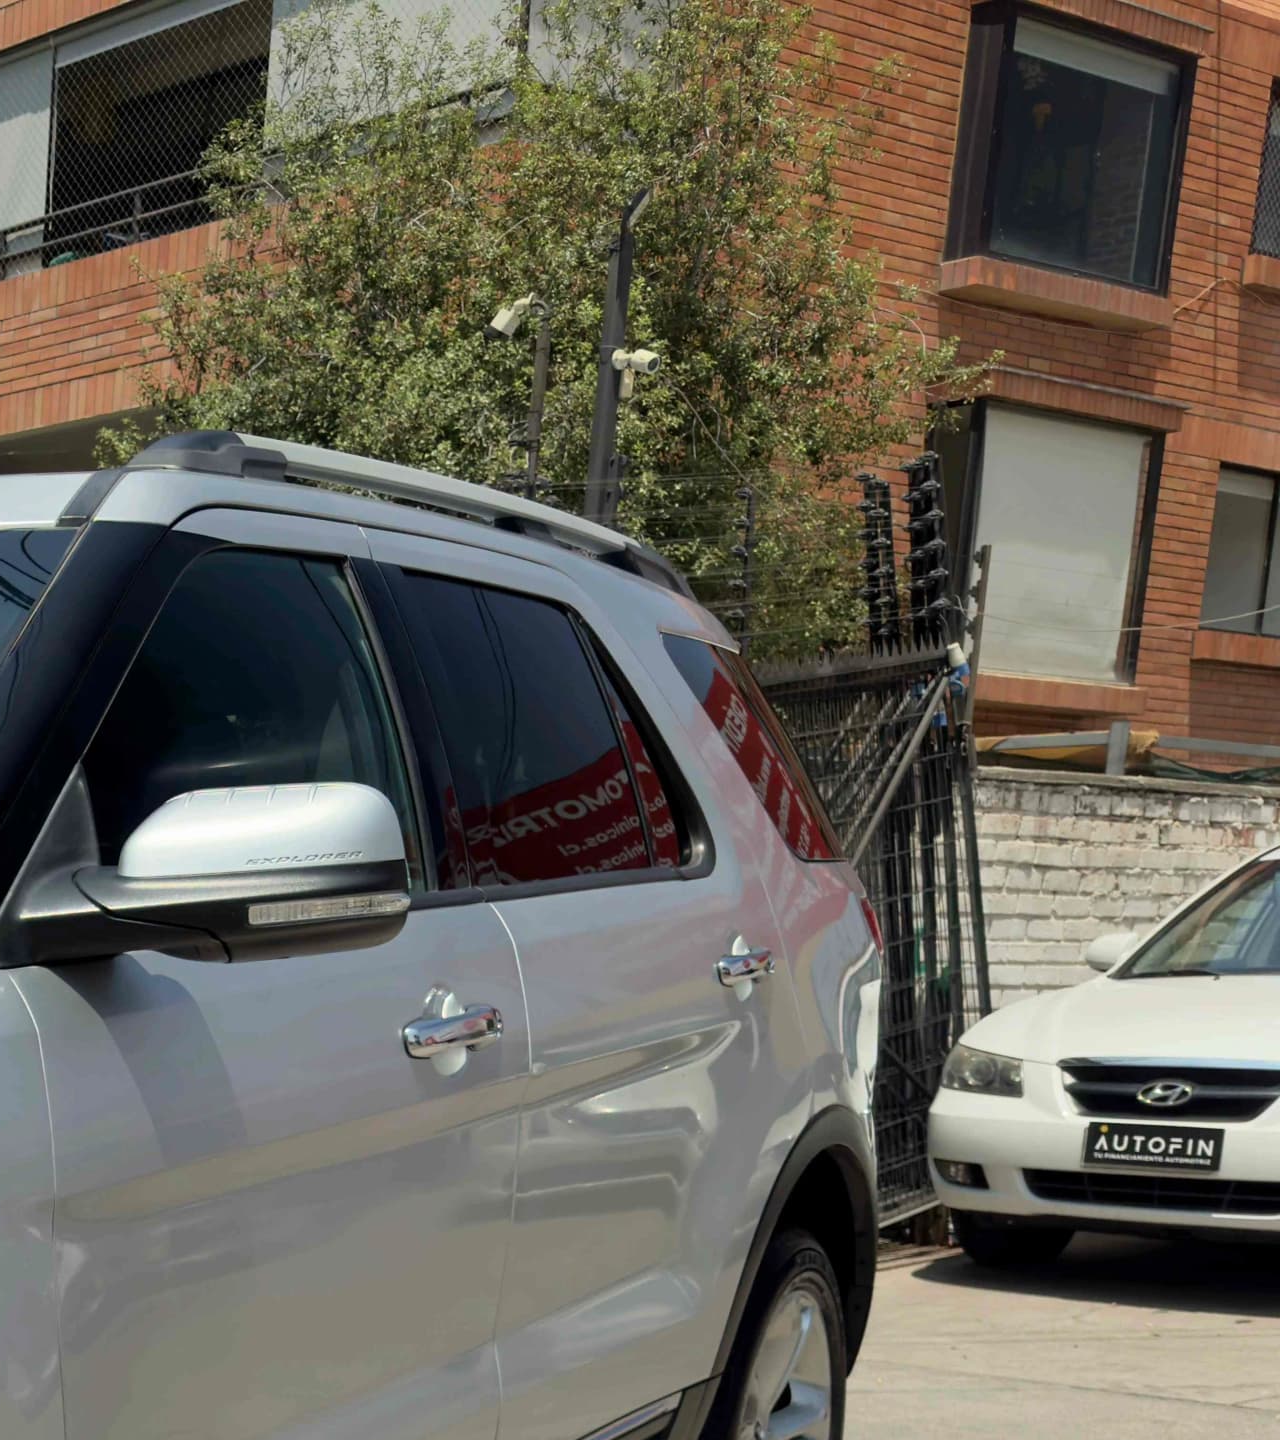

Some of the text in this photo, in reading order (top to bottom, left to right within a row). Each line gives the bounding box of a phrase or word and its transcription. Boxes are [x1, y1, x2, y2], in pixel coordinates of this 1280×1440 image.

[244, 850, 364, 866] EXPLORER
[1094, 1134, 1215, 1157] AUTOFIN
[1104, 1152, 1163, 1163] FINANCIAMIENTO
[1164, 1156, 1212, 1166] AUTOMOTRIZ
